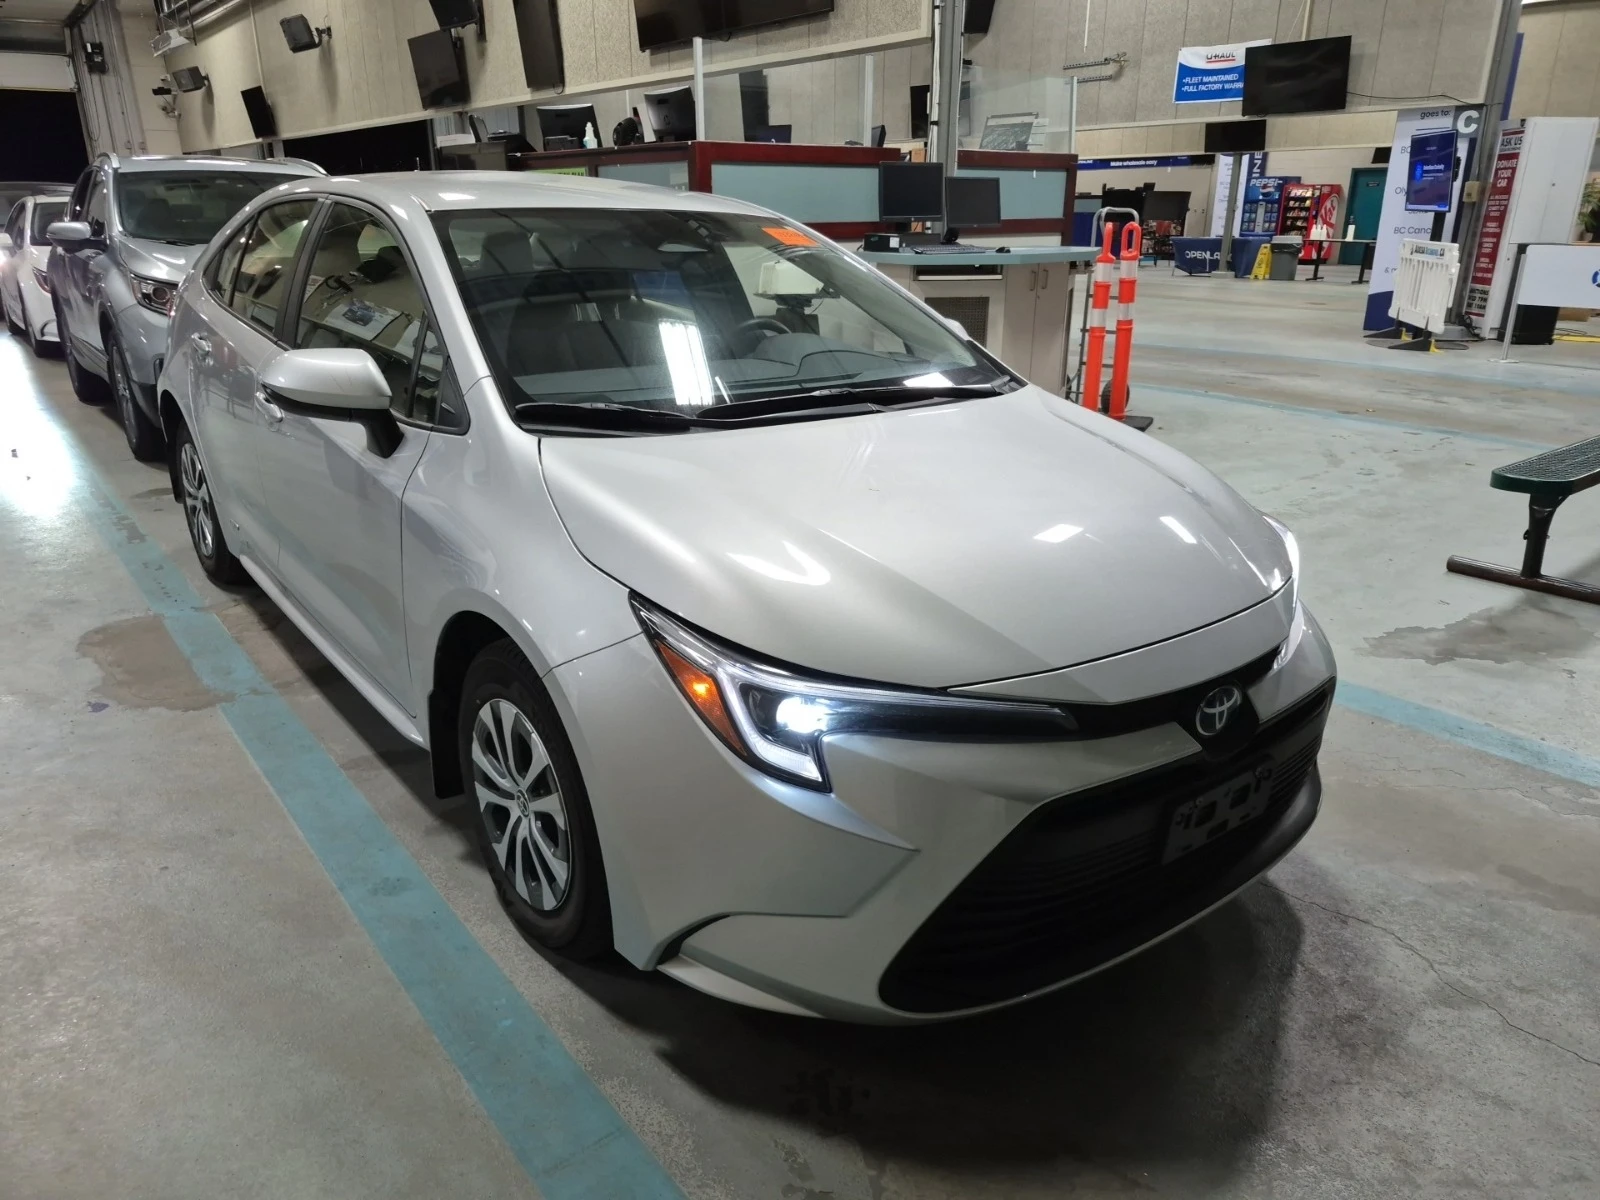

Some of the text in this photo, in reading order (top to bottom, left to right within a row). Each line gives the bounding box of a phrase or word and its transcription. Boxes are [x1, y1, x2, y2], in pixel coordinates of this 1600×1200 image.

[1202, 74, 1239, 82] MAINTAINED
[1198, 83, 1223, 91] FACTORY
[1420, 111, 1439, 119] goes
[1457, 109, 1480, 134] C
[1500, 136, 1524, 147] ASK US
[1496, 160, 1518, 168] DONATE
[1498, 169, 1512, 178] YOUR
[1250, 178, 1279, 186] PEPSI
[1497, 179, 1508, 187] CAR
[1393, 226, 1432, 235] BC Canc
